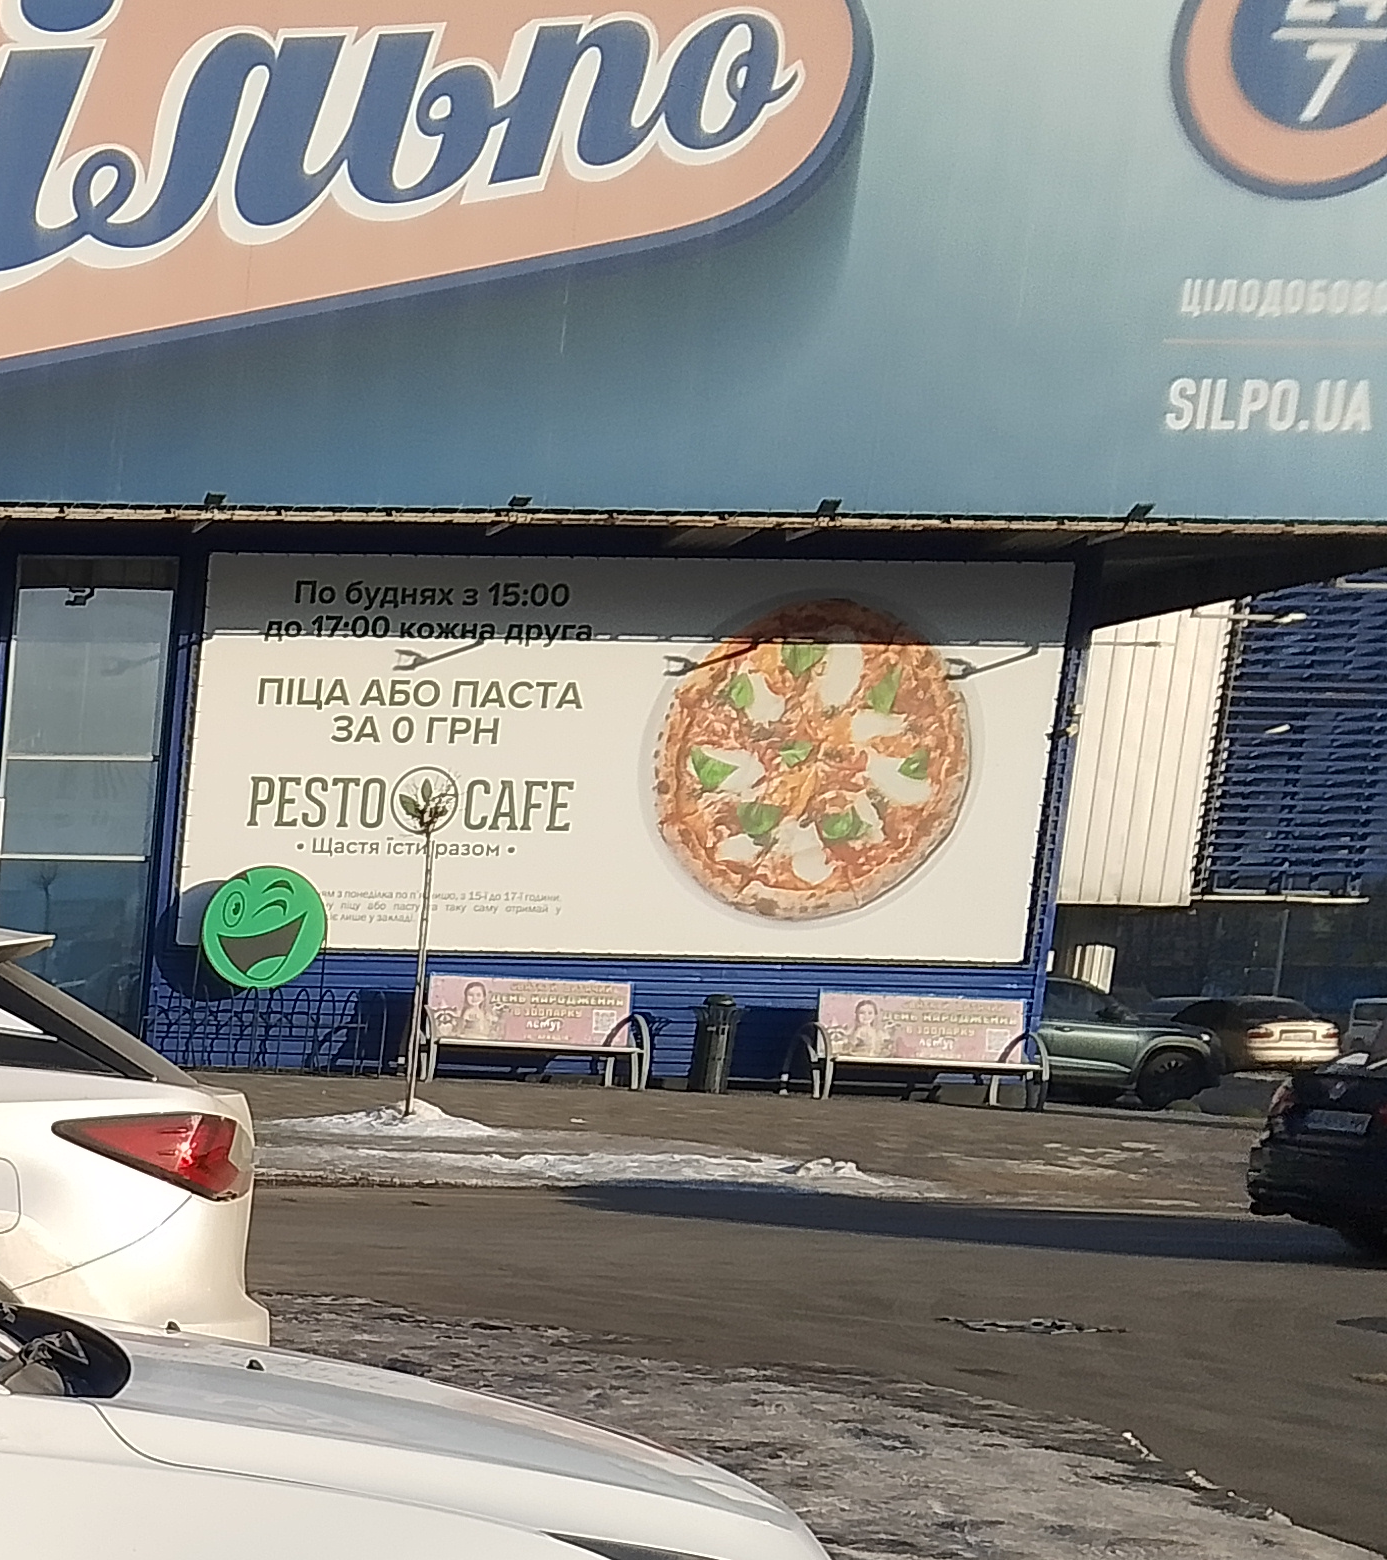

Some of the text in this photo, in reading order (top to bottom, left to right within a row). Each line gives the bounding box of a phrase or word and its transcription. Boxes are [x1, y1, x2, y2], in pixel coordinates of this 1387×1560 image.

[1165, 378, 1371, 431] SILPO.UA
[294, 580, 570, 611] По буднях з 15:00
[264, 615, 593, 648] до 17:00 кожна друга
[257, 677, 583, 711] ПІЦА АБО ПАСТА
[330, 715, 381, 744] ЗА
[426, 717, 500, 745] ГРН
[246, 776, 575, 832] PESTO CAFE
[311, 838, 501, 859] Щастя їсти разом
